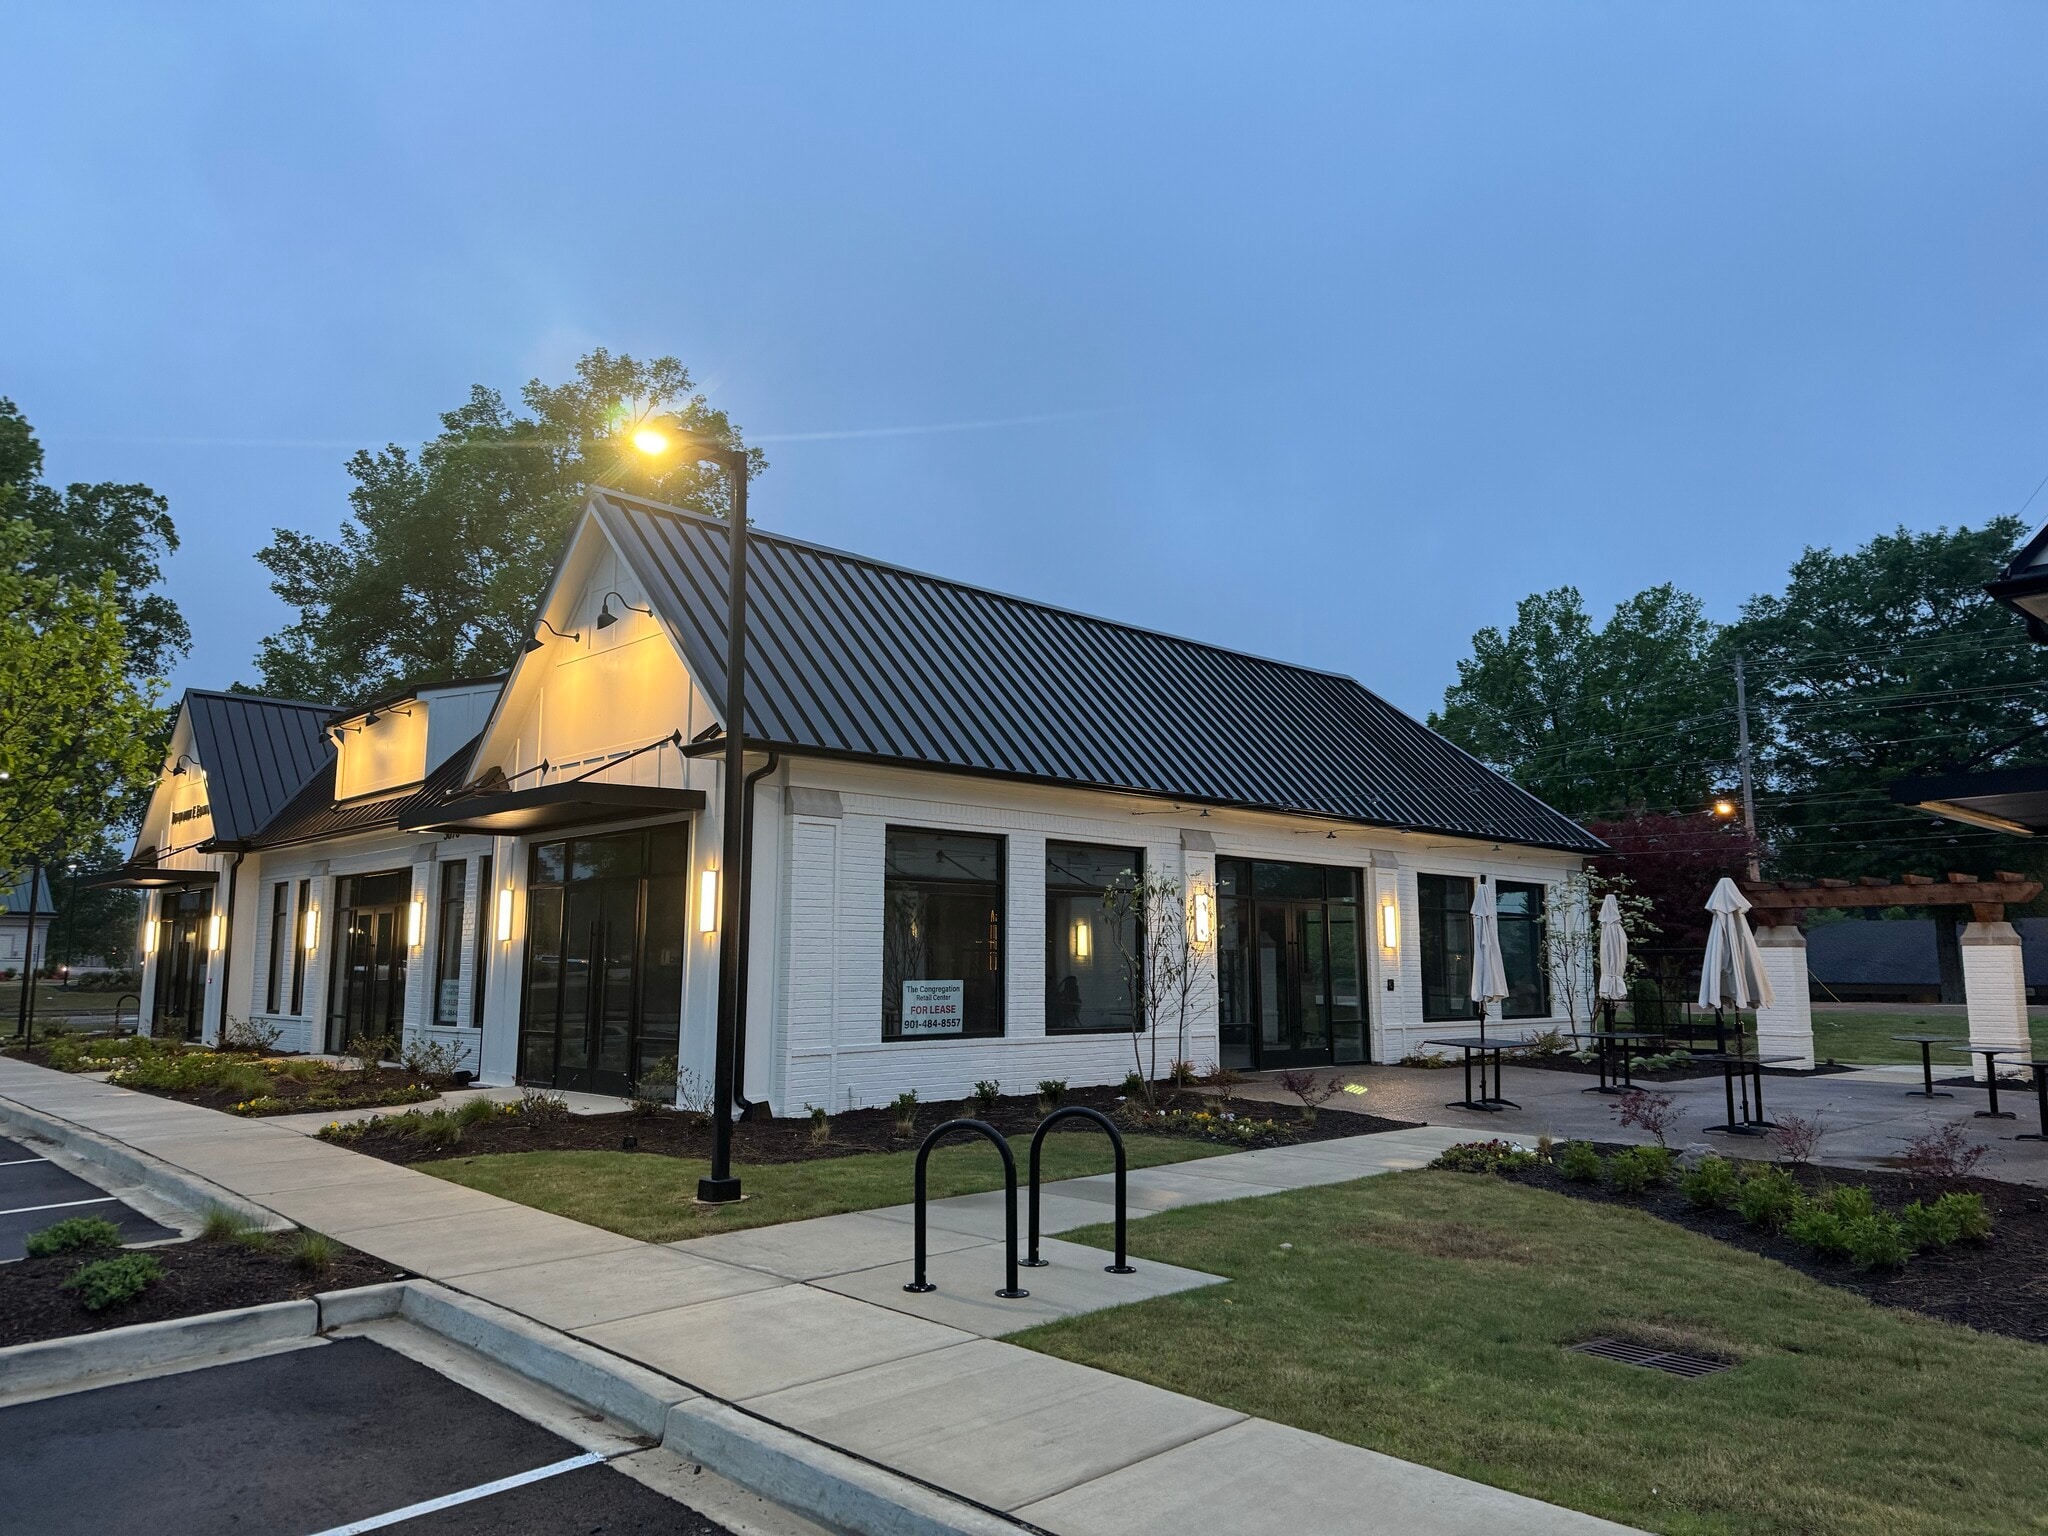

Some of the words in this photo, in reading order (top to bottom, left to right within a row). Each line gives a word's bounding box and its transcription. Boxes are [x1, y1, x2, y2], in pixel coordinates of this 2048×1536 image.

[920, 985, 960, 994] Congregation
[911, 1006, 928, 1015] FOR
[930, 1005, 956, 1014] LEASE
[904, 1018, 961, 1029] 901-484-8557
